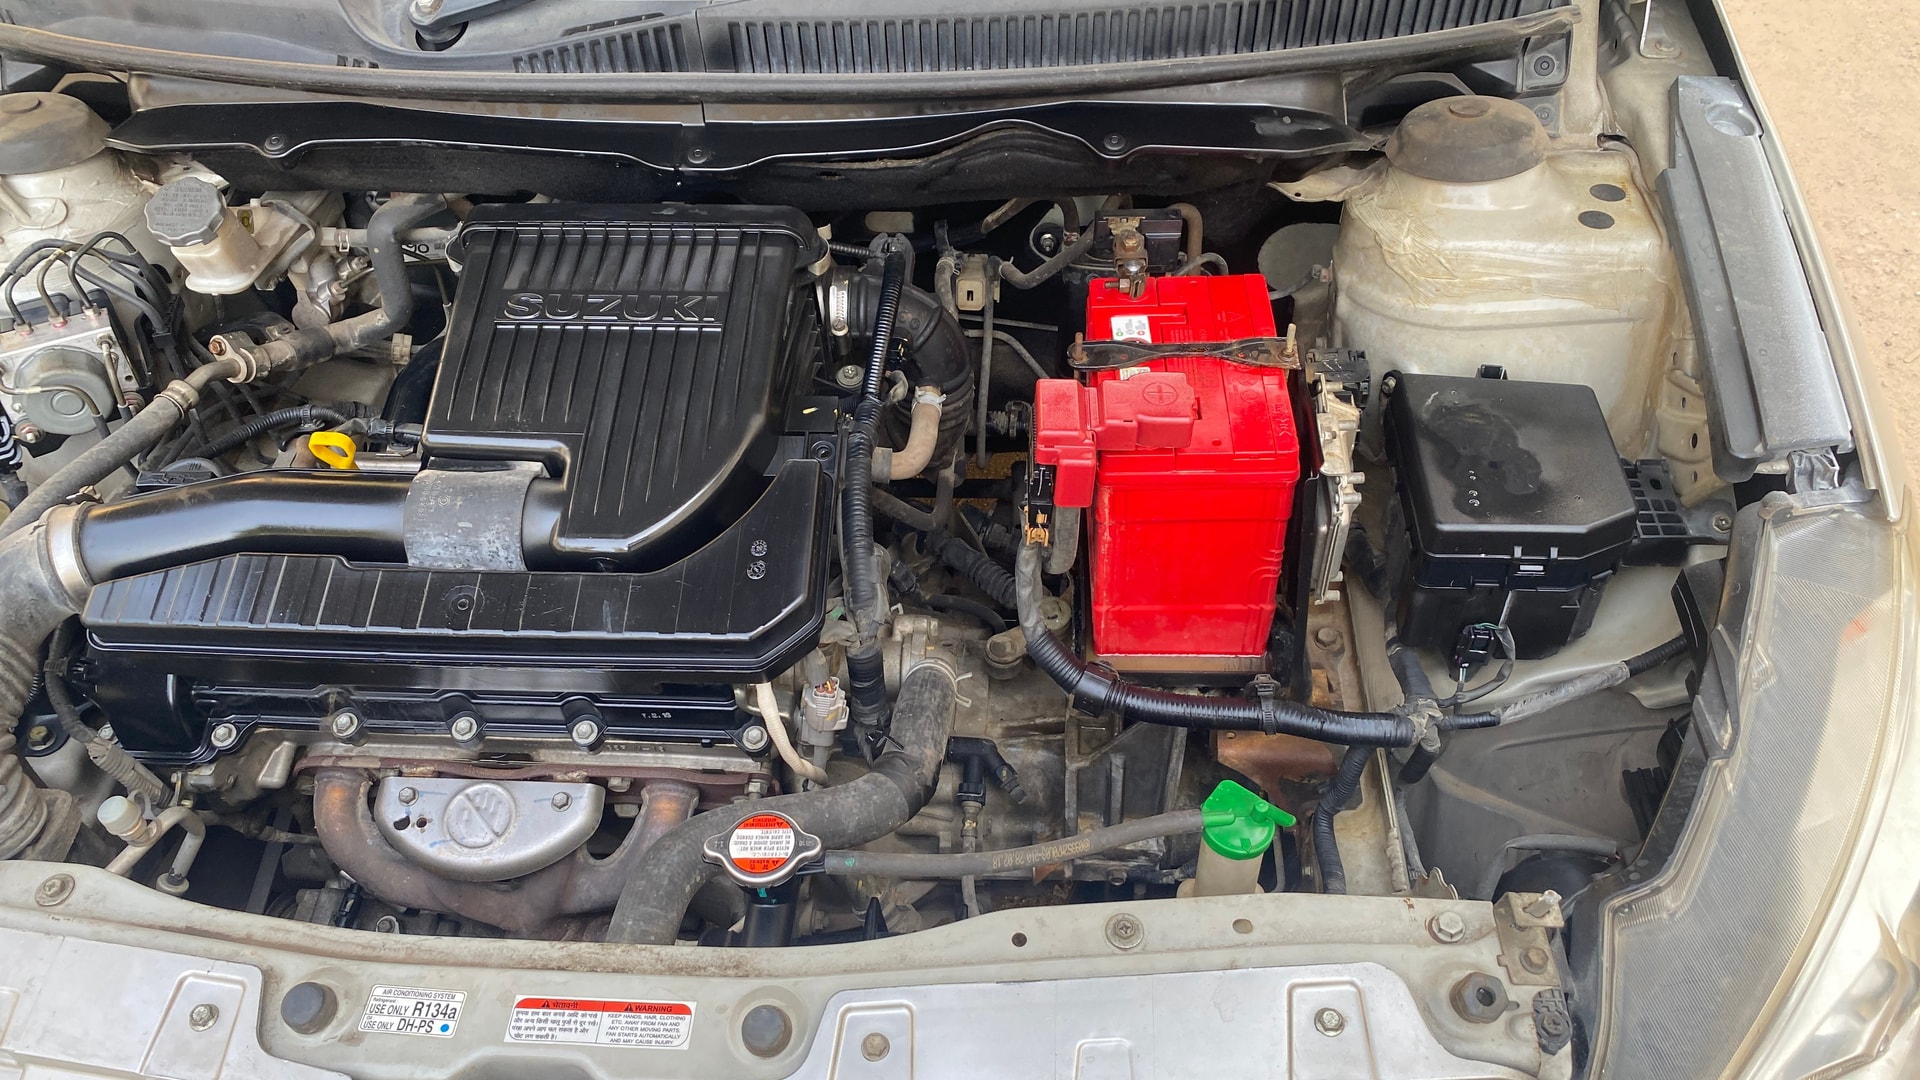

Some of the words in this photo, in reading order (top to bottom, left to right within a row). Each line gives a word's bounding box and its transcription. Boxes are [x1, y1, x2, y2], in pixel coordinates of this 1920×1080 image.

[504, 292, 719, 321] SUZUKI
[393, 989, 433, 998] CONDITIONING
[369, 1003, 386, 1014] USE
[387, 1004, 410, 1015] ONLY
[412, 1001, 457, 1019] R134a
[363, 1020, 377, 1029] USE
[377, 1021, 394, 1030] ONLY
[397, 1018, 434, 1033] DH-PS
